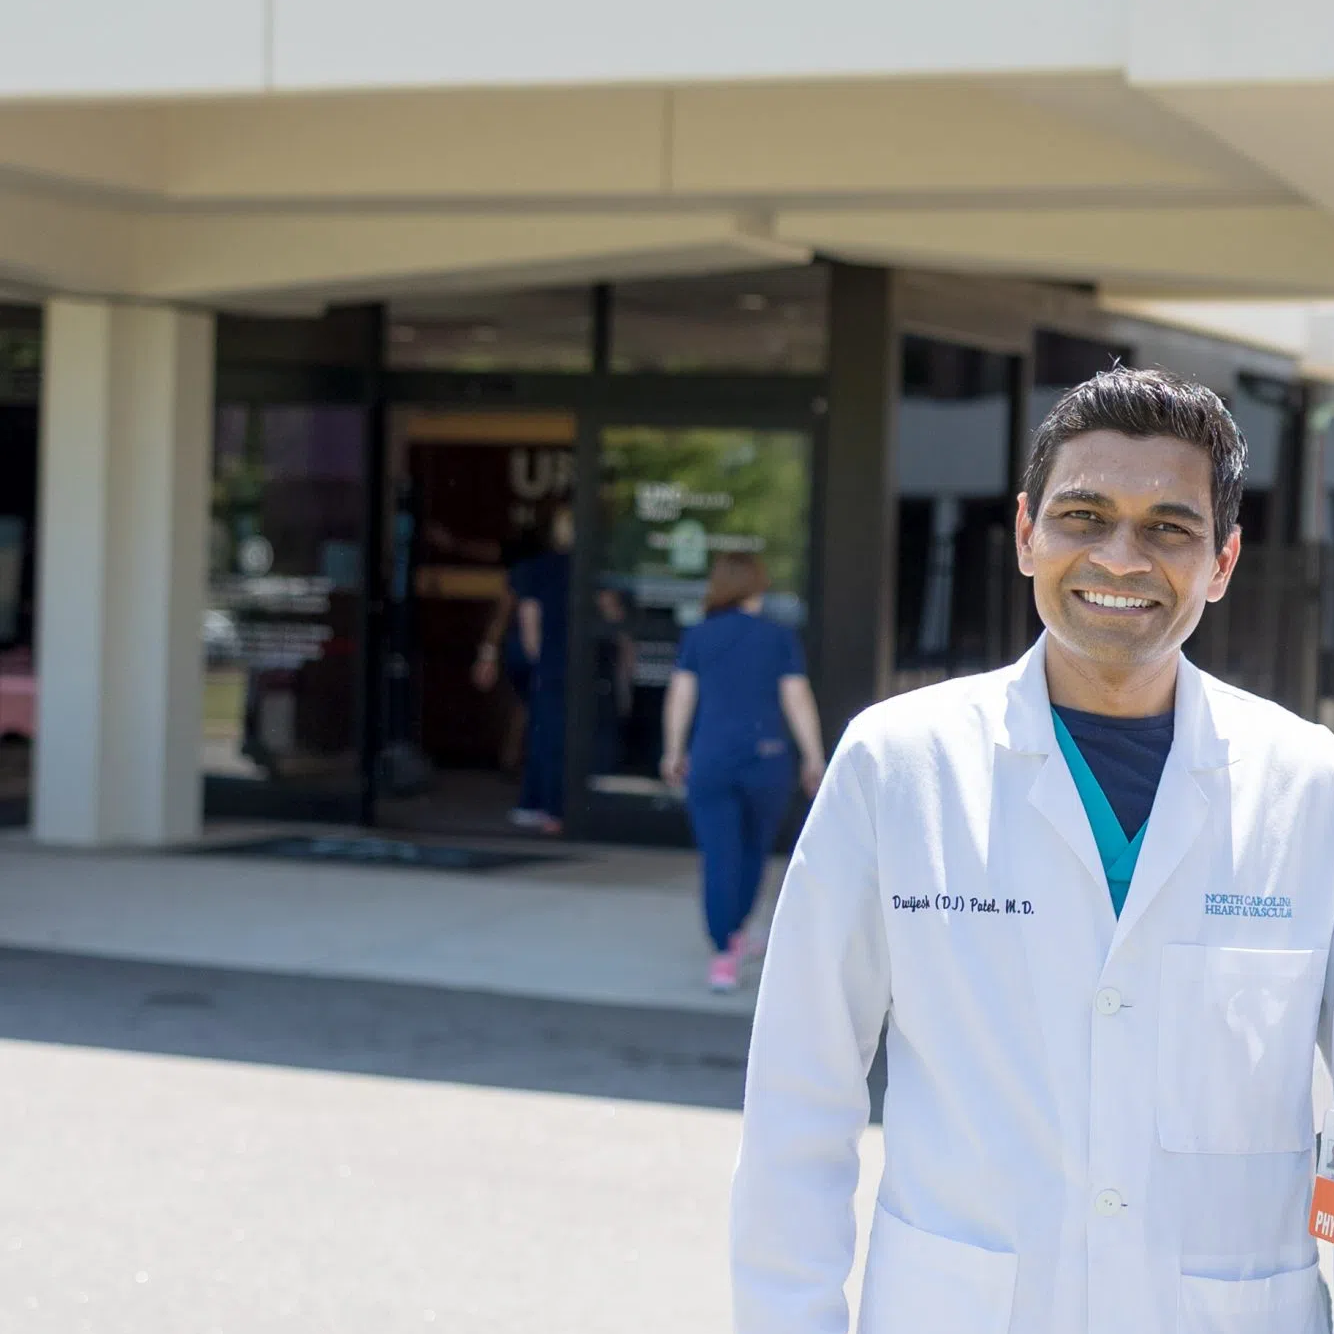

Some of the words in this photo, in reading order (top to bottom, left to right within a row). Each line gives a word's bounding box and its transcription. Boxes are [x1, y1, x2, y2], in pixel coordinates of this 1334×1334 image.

[935, 893, 965, 912] (DJ)
[970, 897, 1000, 913] Patel,
[1006, 898, 1034, 915] M.D.
[1204, 893, 1243, 905] NORTH
[1204, 905, 1241, 916] HEART
[1242, 907, 1249, 917] &
